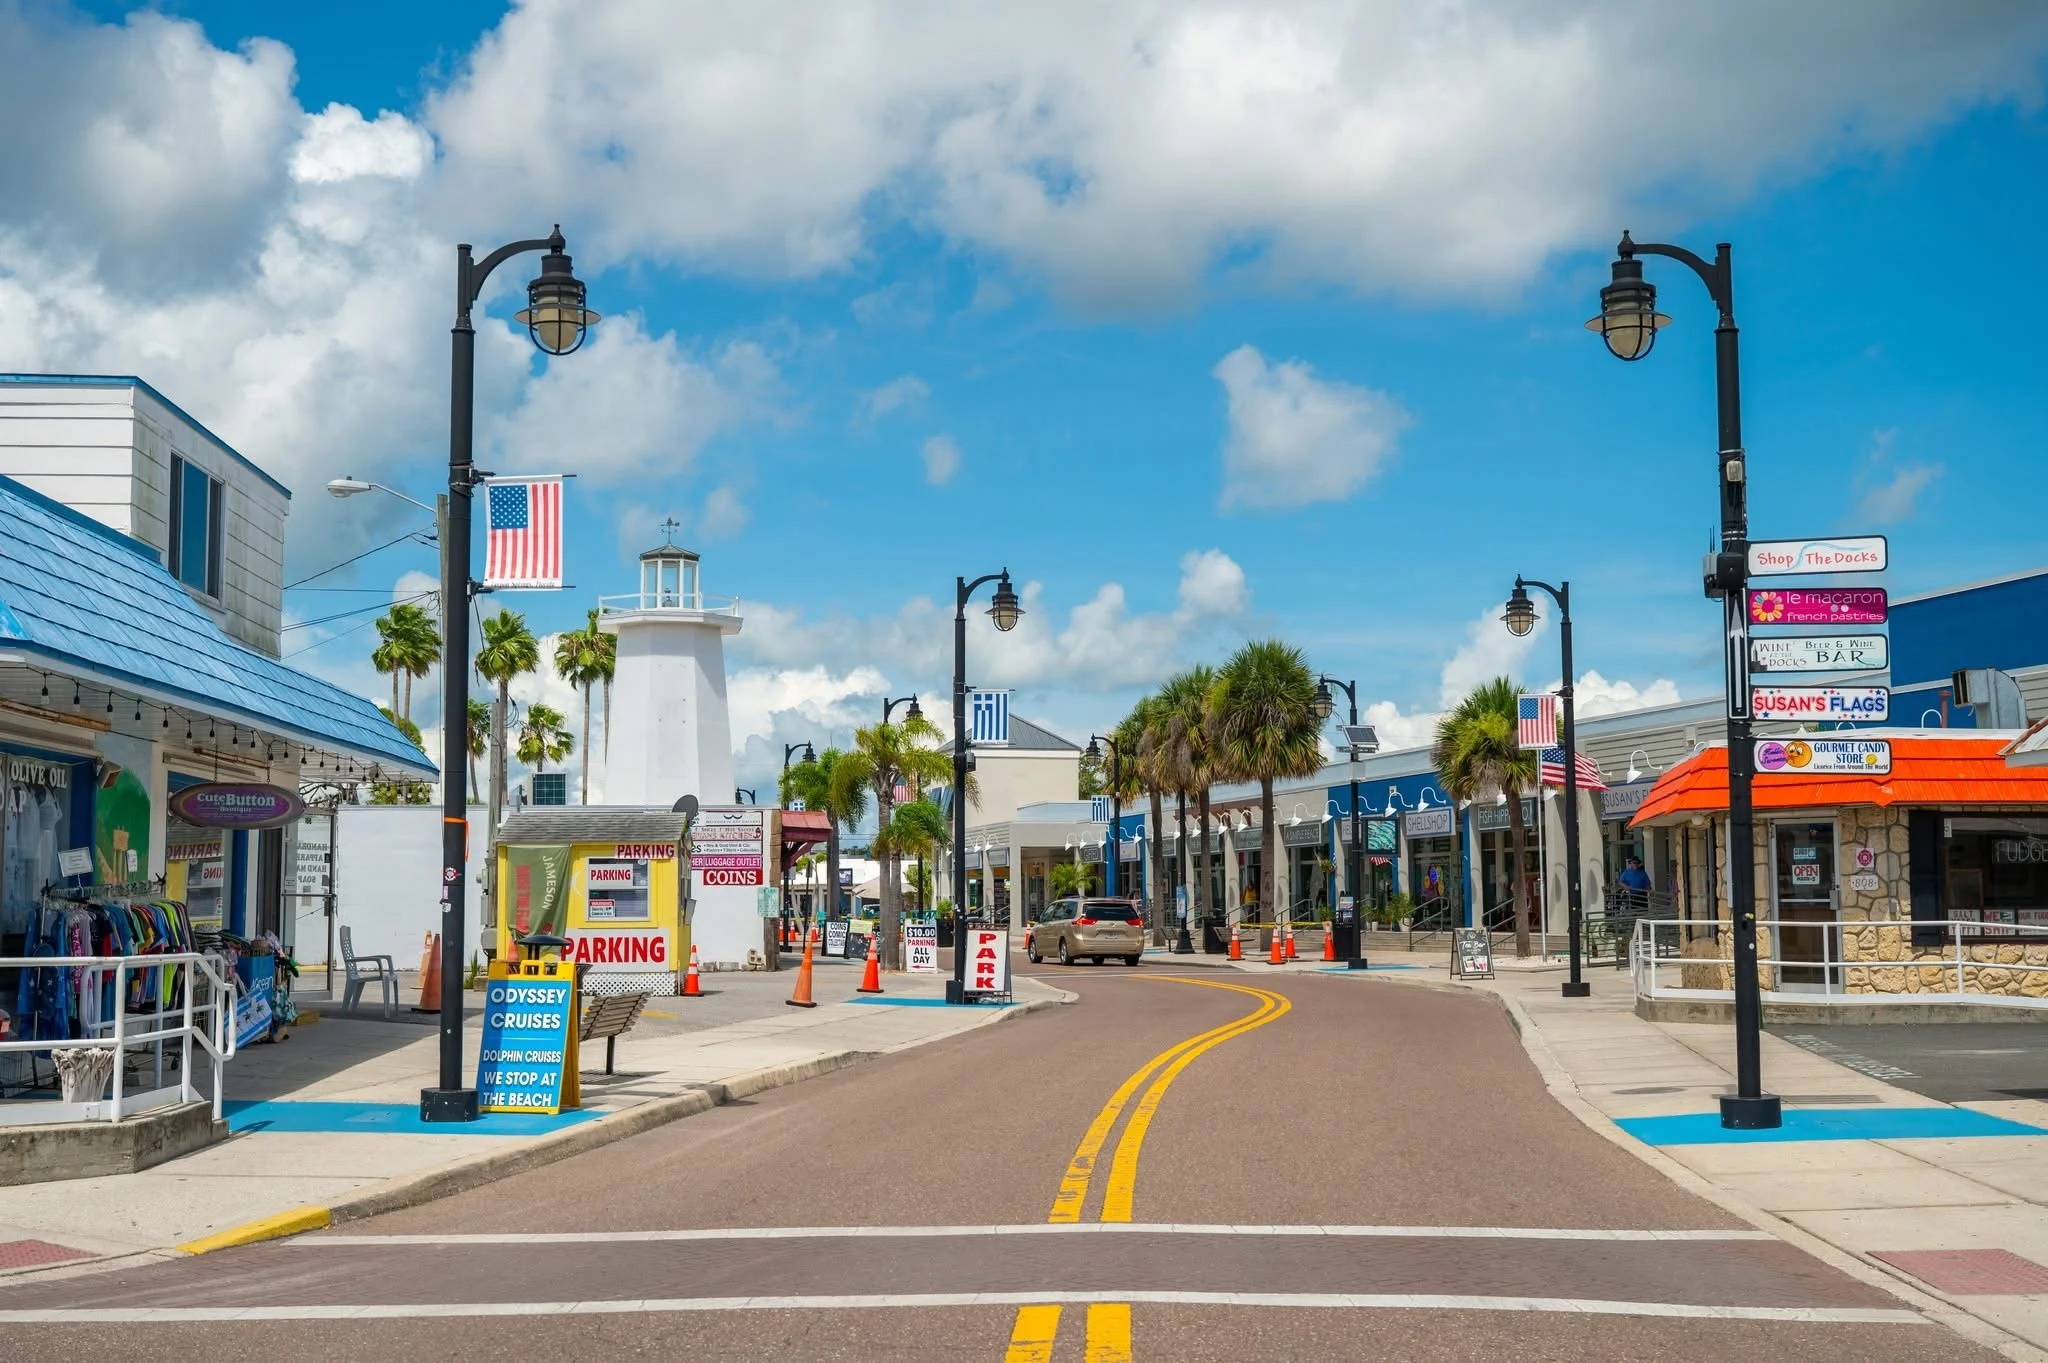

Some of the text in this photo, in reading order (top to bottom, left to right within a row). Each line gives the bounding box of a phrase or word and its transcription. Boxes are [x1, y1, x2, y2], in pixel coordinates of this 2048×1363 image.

[1757, 552, 1794, 567] Shop
[1805, 553, 1832, 564] The
[1786, 591, 1883, 604] le macaron
[1787, 612, 1884, 623] french pastries
[1769, 658, 1807, 667] DOCKS
[1816, 650, 1876, 666] BAR
[1754, 696, 1885, 711] SUSAN'S FLAGS
[1814, 742, 1885, 753] GOURMET CANDY
[1836, 753, 1864, 764] STORE
[11, 760, 67, 788] OLIVE OIL
[1604, 789, 1641, 808] SUSAN'S
[1479, 807, 1493, 824] FISH
[617, 844, 675, 858] PARKING
[1996, 841, 2048, 862] FUDGE
[705, 856, 736, 867] LUGGAGE
[736, 856, 760, 866] OUTLET
[590, 869, 631, 880] PARKING
[705, 870, 757, 885] COINS
[1793, 865, 1818, 877] OPEN
[542, 855, 557, 910] JAMESON
[908, 928, 935, 937] $10.00
[561, 936, 665, 963] PARKING
[907, 939, 935, 947] PARKING
[914, 947, 929, 955] ALL
[913, 956, 930, 964] DAY
[976, 933, 997, 988] PARK
[490, 987, 567, 1004] ODYSSEY
[490, 1012, 561, 1029] CRUISES
[483, 1050, 562, 1063] DOLPHIN CRUISES
[485, 1071, 557, 1086] WE STOP AT
[483, 1092, 552, 1107] THE BEACH
